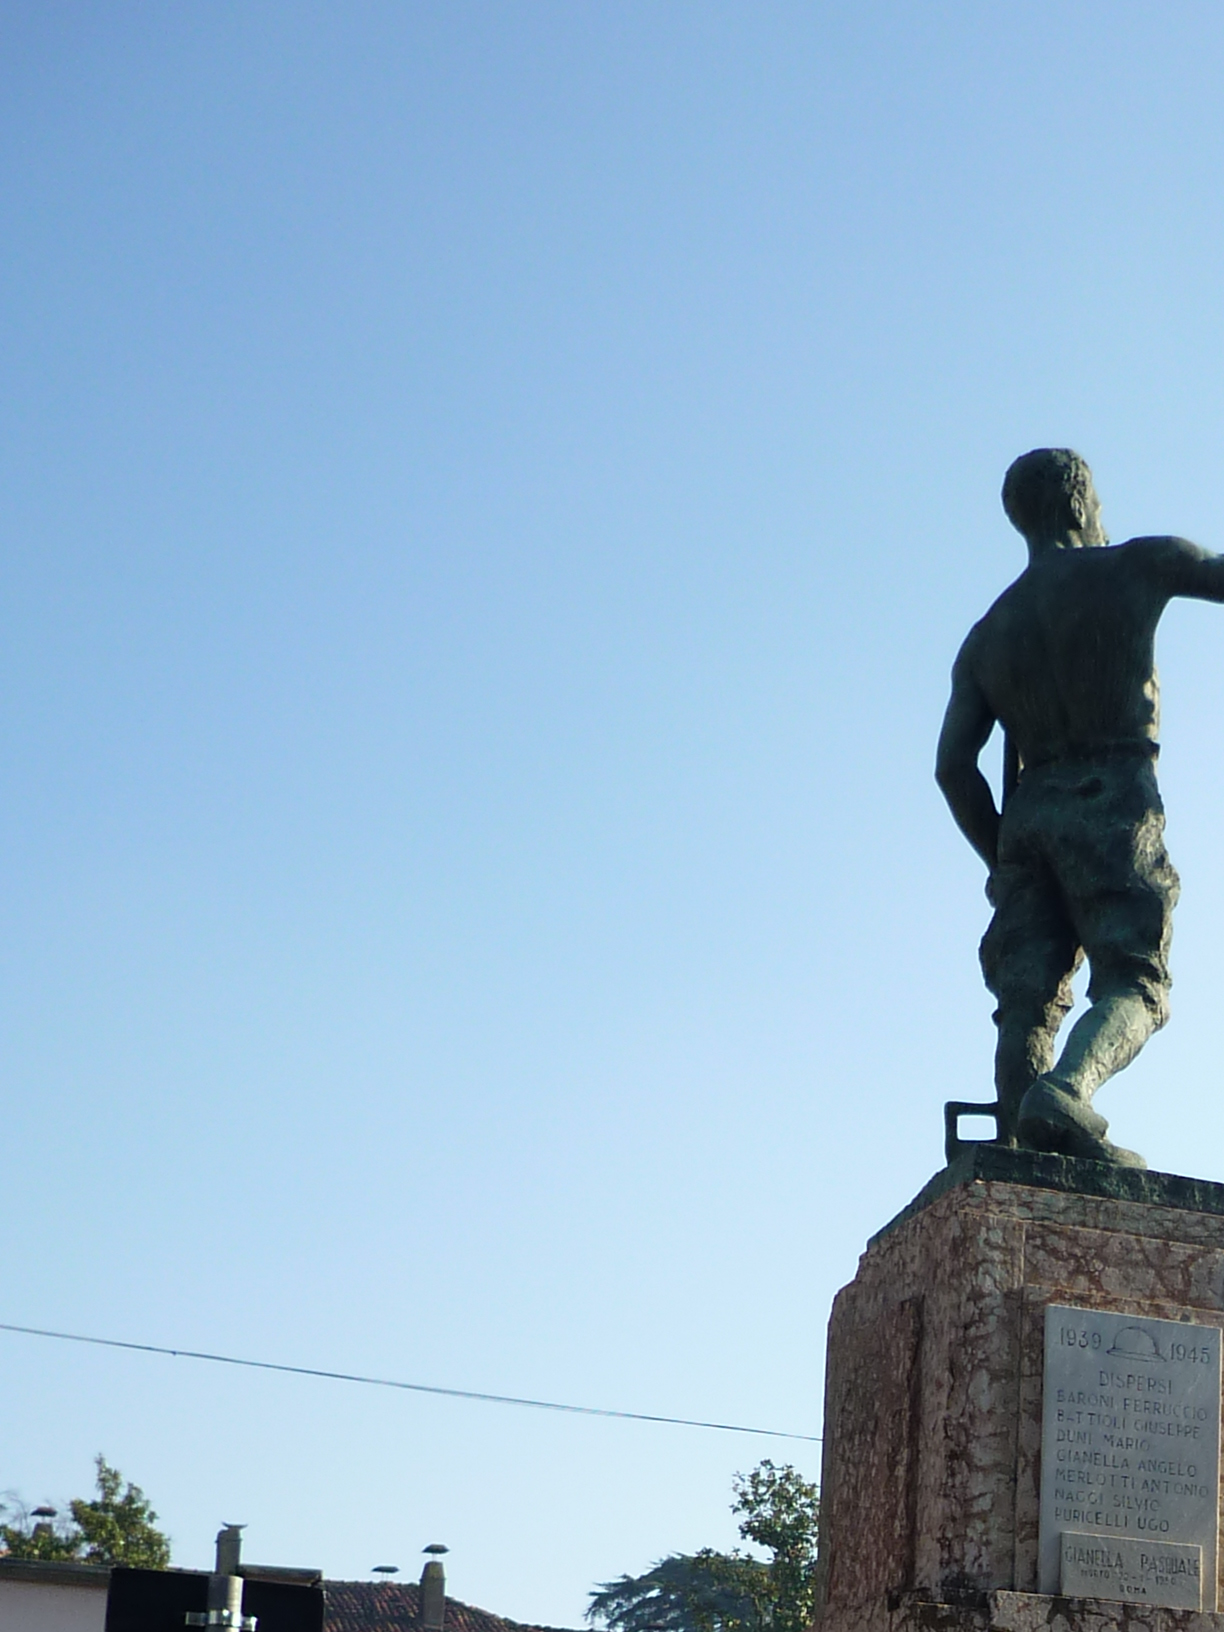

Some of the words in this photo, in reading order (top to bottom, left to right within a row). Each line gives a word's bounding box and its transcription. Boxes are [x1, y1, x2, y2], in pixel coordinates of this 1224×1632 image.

[1059, 1327, 1102, 1350] 1939
[1170, 1343, 1211, 1364] 1945
[1099, 1370, 1172, 1395] DISPERSI
[1056, 1389, 1114, 1408] BARONI
[1123, 1397, 1208, 1421] FERRUCCIO
[1103, 1434, 1150, 1451] MARIO
[1134, 1419, 1200, 1440] GIUSEPPE
[1056, 1449, 1130, 1469] GIANELLA
[1138, 1459, 1197, 1477] ANGELO
[1055, 1468, 1135, 1489] MERLOTTI
[1141, 1479, 1209, 1498] ANTONIO
[1113, 1494, 1160, 1512] SILVIO
[1055, 1506, 1128, 1528] PURICELLI
[1137, 1516, 1170, 1532] UGO
[1064, 1546, 1123, 1568] GIANELLA
[1140, 1553, 1200, 1577] PASQUALE
